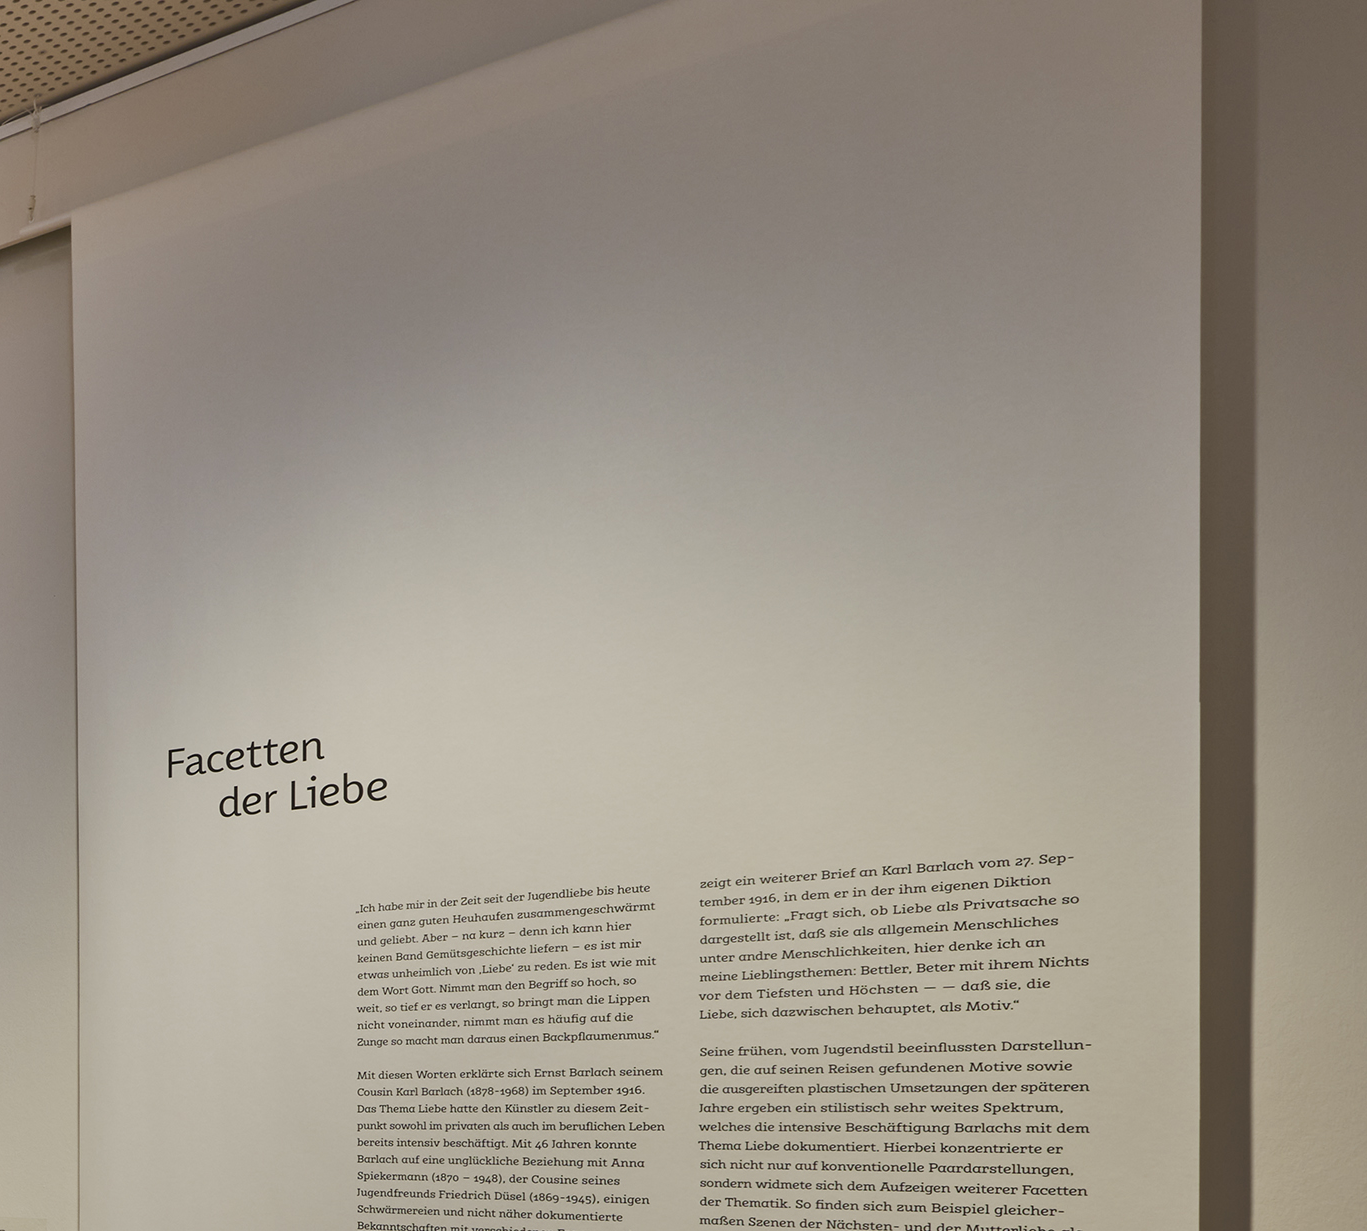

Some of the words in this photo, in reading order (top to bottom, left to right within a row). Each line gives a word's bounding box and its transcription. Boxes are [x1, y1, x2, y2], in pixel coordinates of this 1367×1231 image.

[167, 737, 324, 778] Facetten
[219, 786, 277, 818] der
[291, 773, 388, 810] Liebe
[378, 902, 403, 912] habe
[406, 900, 425, 910] mir
[427, 899, 437, 908] in
[440, 898, 458, 907] der
[461, 896, 481, 906] Zeit
[484, 894, 503, 904] seit
[506, 893, 525, 902] der
[528, 888, 593, 902] Jugendliebe
[597, 886, 614, 896] bis
[617, 885, 650, 894] heute
[357, 921, 386, 930] einen
[390, 920, 415, 930] ganz
[419, 918, 449, 928] guten
[453, 912, 513, 923] Heuhaufen
[517, 903, 655, 919] zusammengeschwärmt
[700, 1047, 734, 1056] Seine
[823, 1043, 894, 1056] Jugendstil
[898, 1042, 997, 1053] beeinflussten
[1001, 1040, 1091, 1051] Darstellun-
[357, 1071, 375, 1079] Mit
[378, 1071, 413, 1079] diesen
[416, 1070, 457, 1079] Worten
[460, 1069, 504, 1078] erklärte
[508, 1068, 531, 1078] sich
[534, 1069, 565, 1077] Ernst
[569, 1067, 616, 1077] Barlach
[619, 1067, 663, 1076] seinem
[700, 1084, 719, 1094] die
[722, 1084, 804, 1096] ausgereiften
[808, 1083, 886, 1096] plastischen
[890, 1083, 988, 1095] Umsetzungen
[992, 1082, 1017, 1092] der
[1021, 1082, 1090, 1094] späteren
